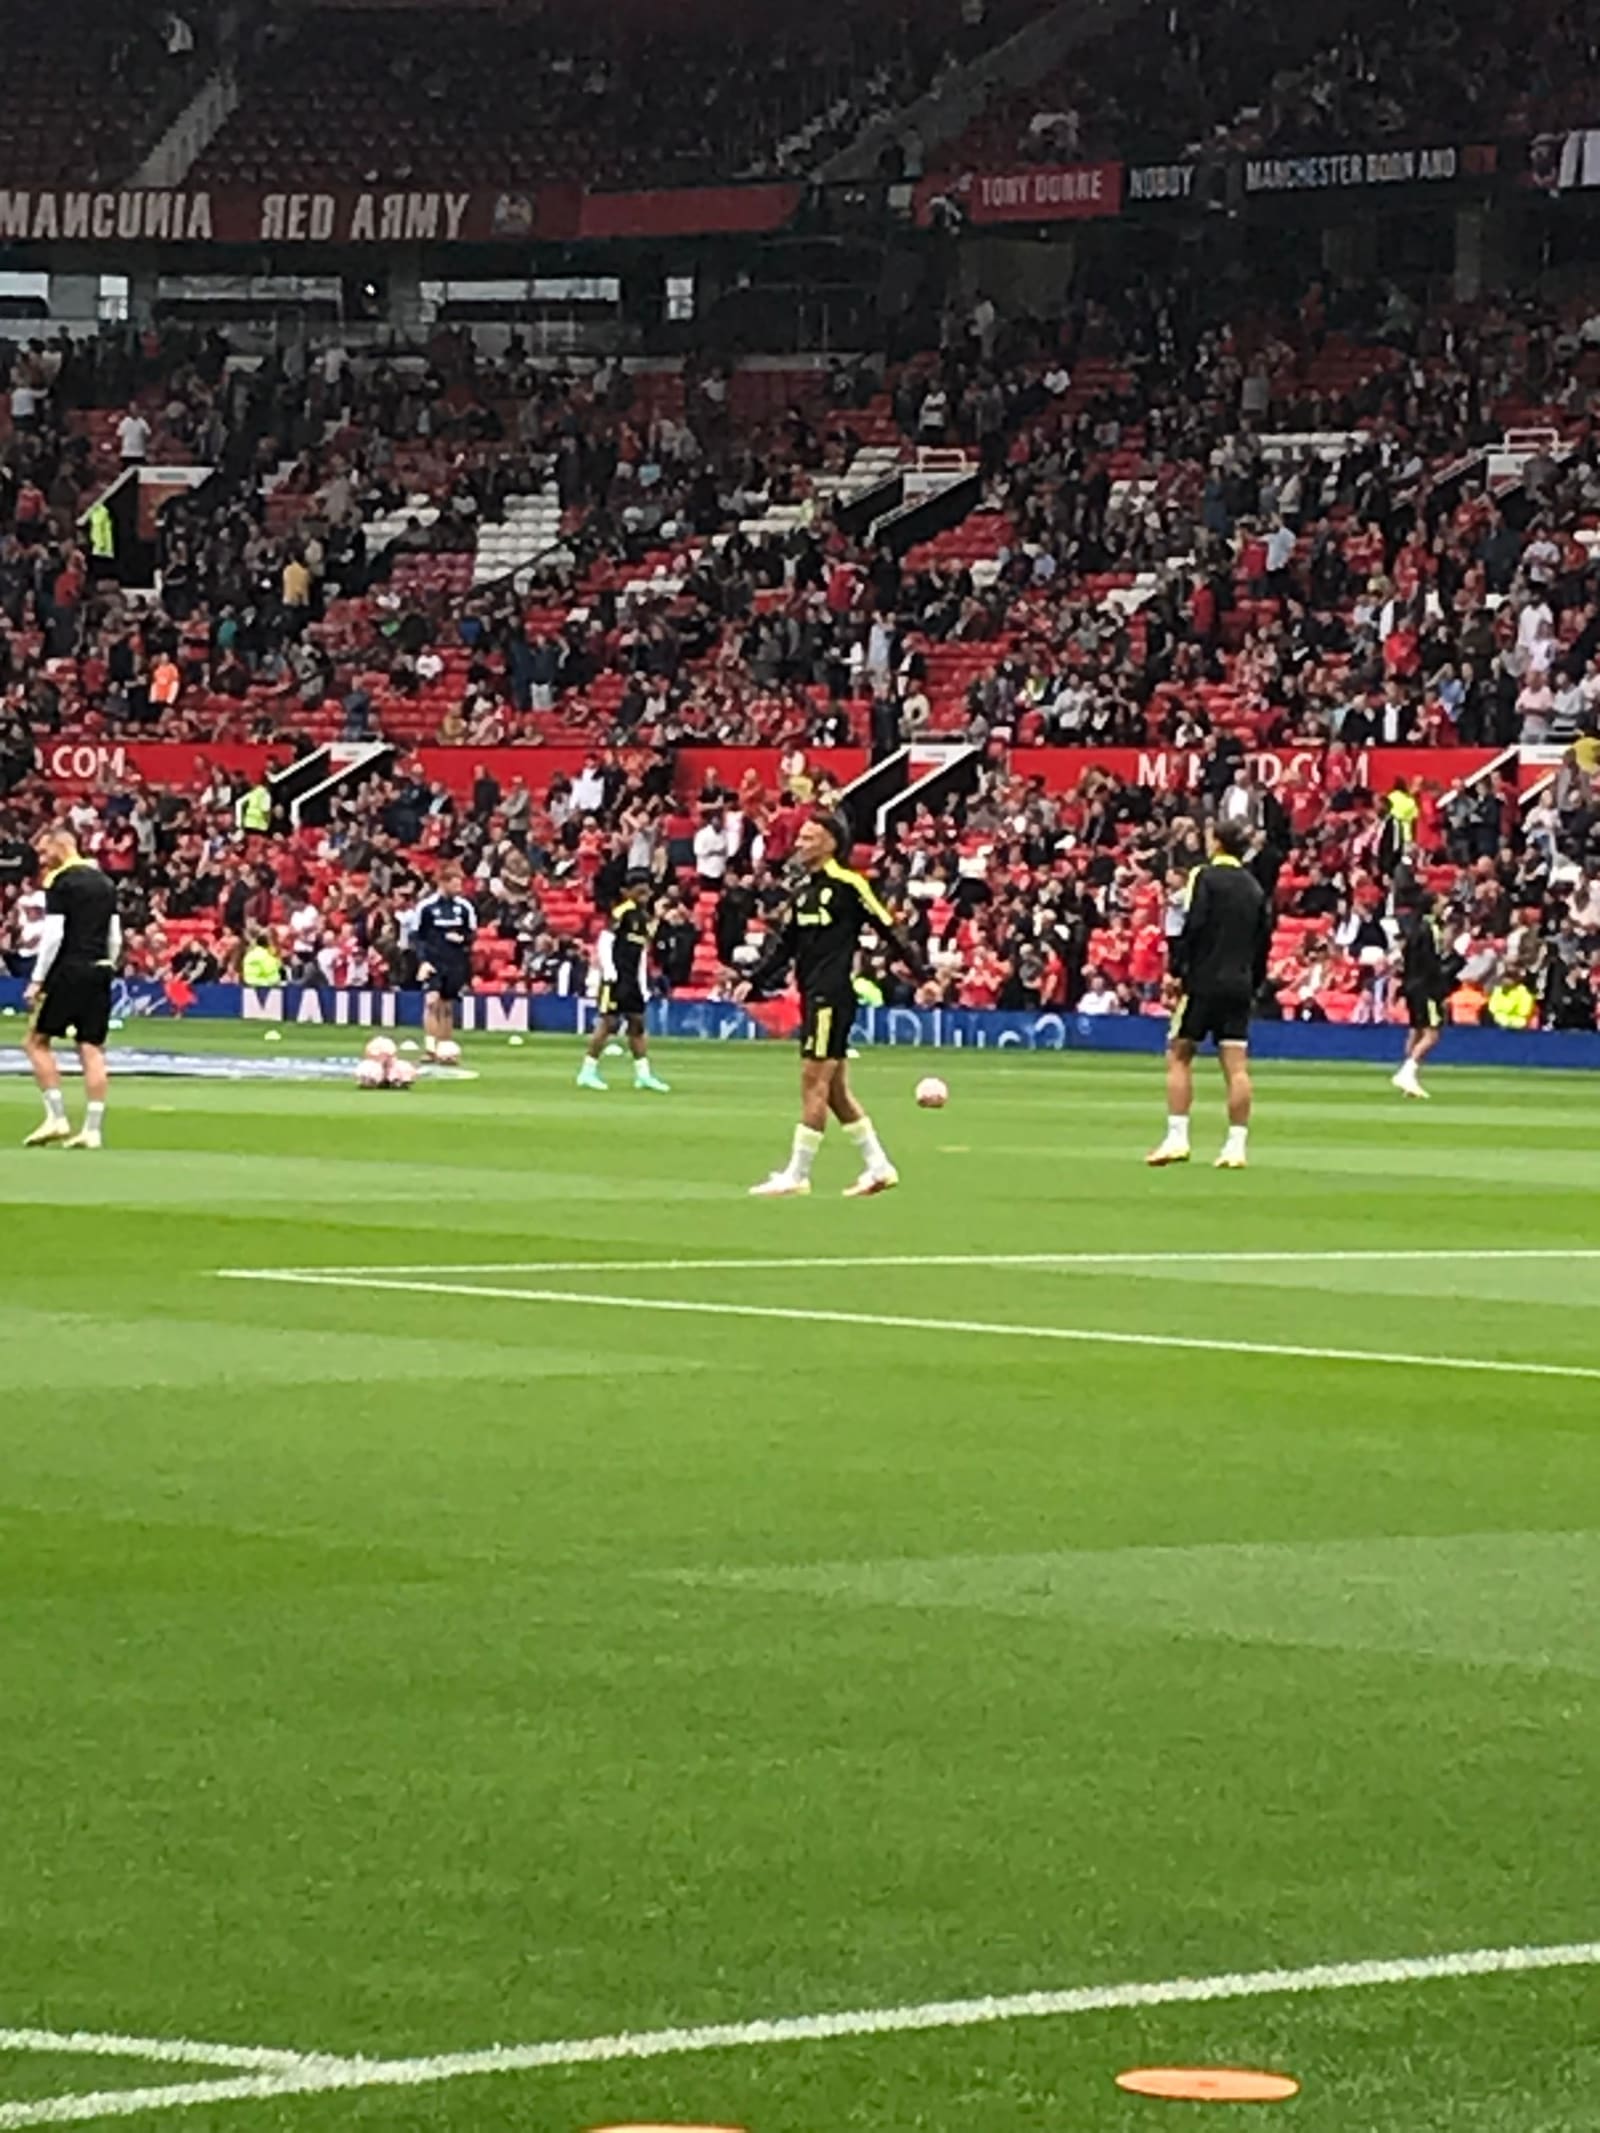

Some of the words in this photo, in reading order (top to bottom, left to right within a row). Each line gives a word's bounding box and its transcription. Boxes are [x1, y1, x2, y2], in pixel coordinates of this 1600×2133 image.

[1246, 154, 1364, 191] MANCHESTER
[261, 193, 336, 241] RED
[350, 192, 470, 240] ARMY
